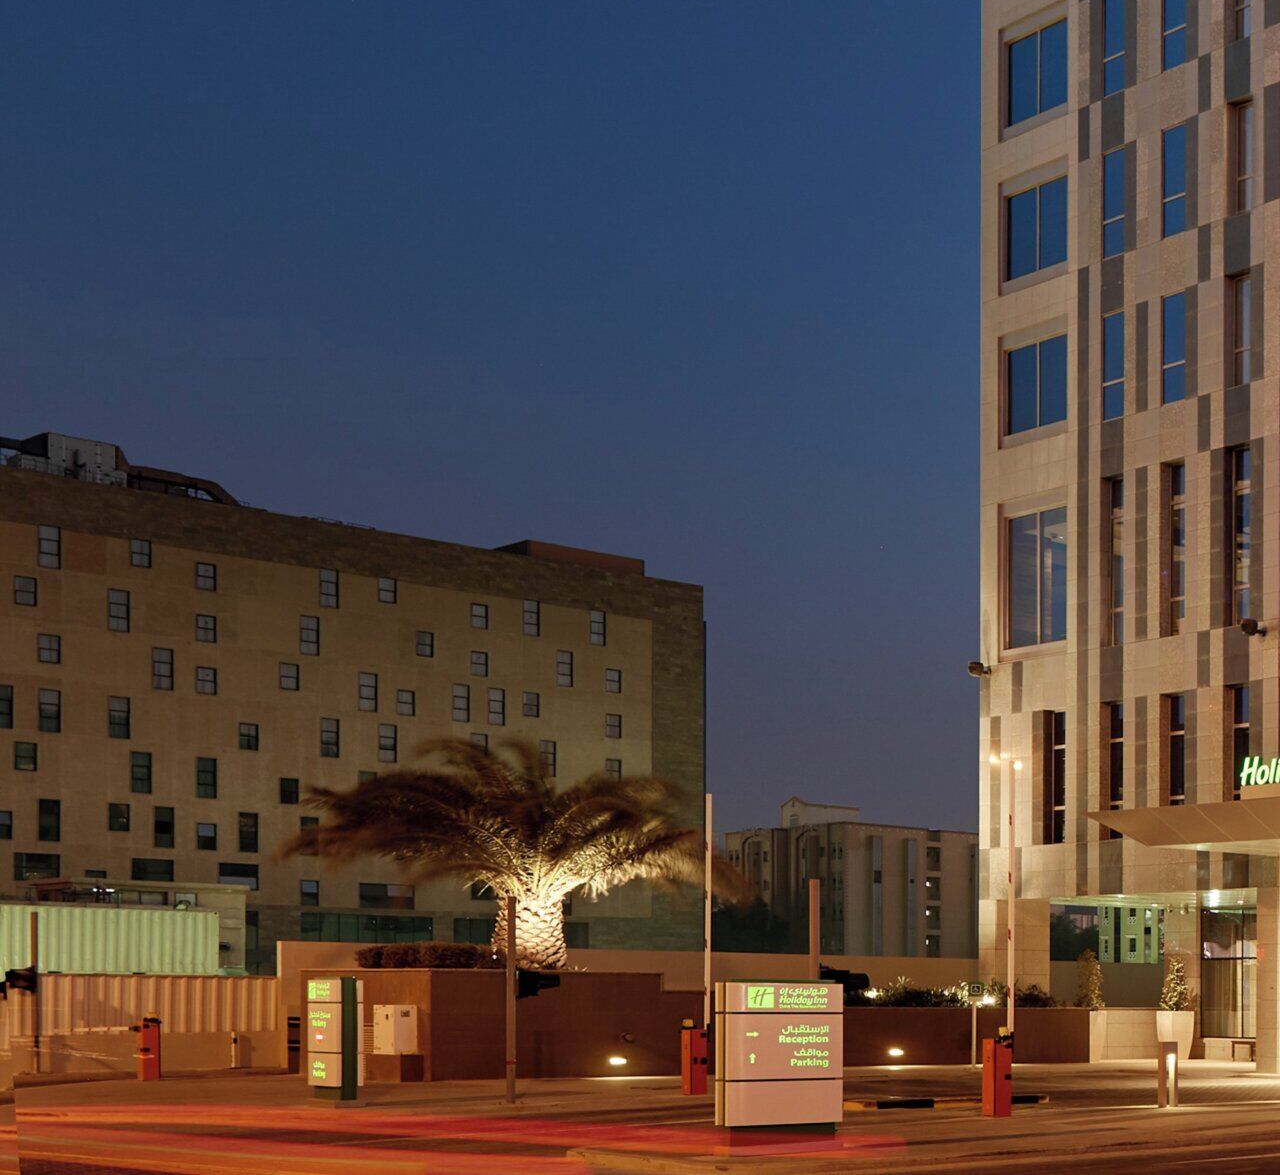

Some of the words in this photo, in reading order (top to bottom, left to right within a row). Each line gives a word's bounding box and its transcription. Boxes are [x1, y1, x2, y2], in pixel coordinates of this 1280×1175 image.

[779, 995, 813, 1005] Holiday
[813, 995, 828, 1004] Inn
[778, 1034, 829, 1045] Reception
[790, 1057, 829, 1067] Parking
